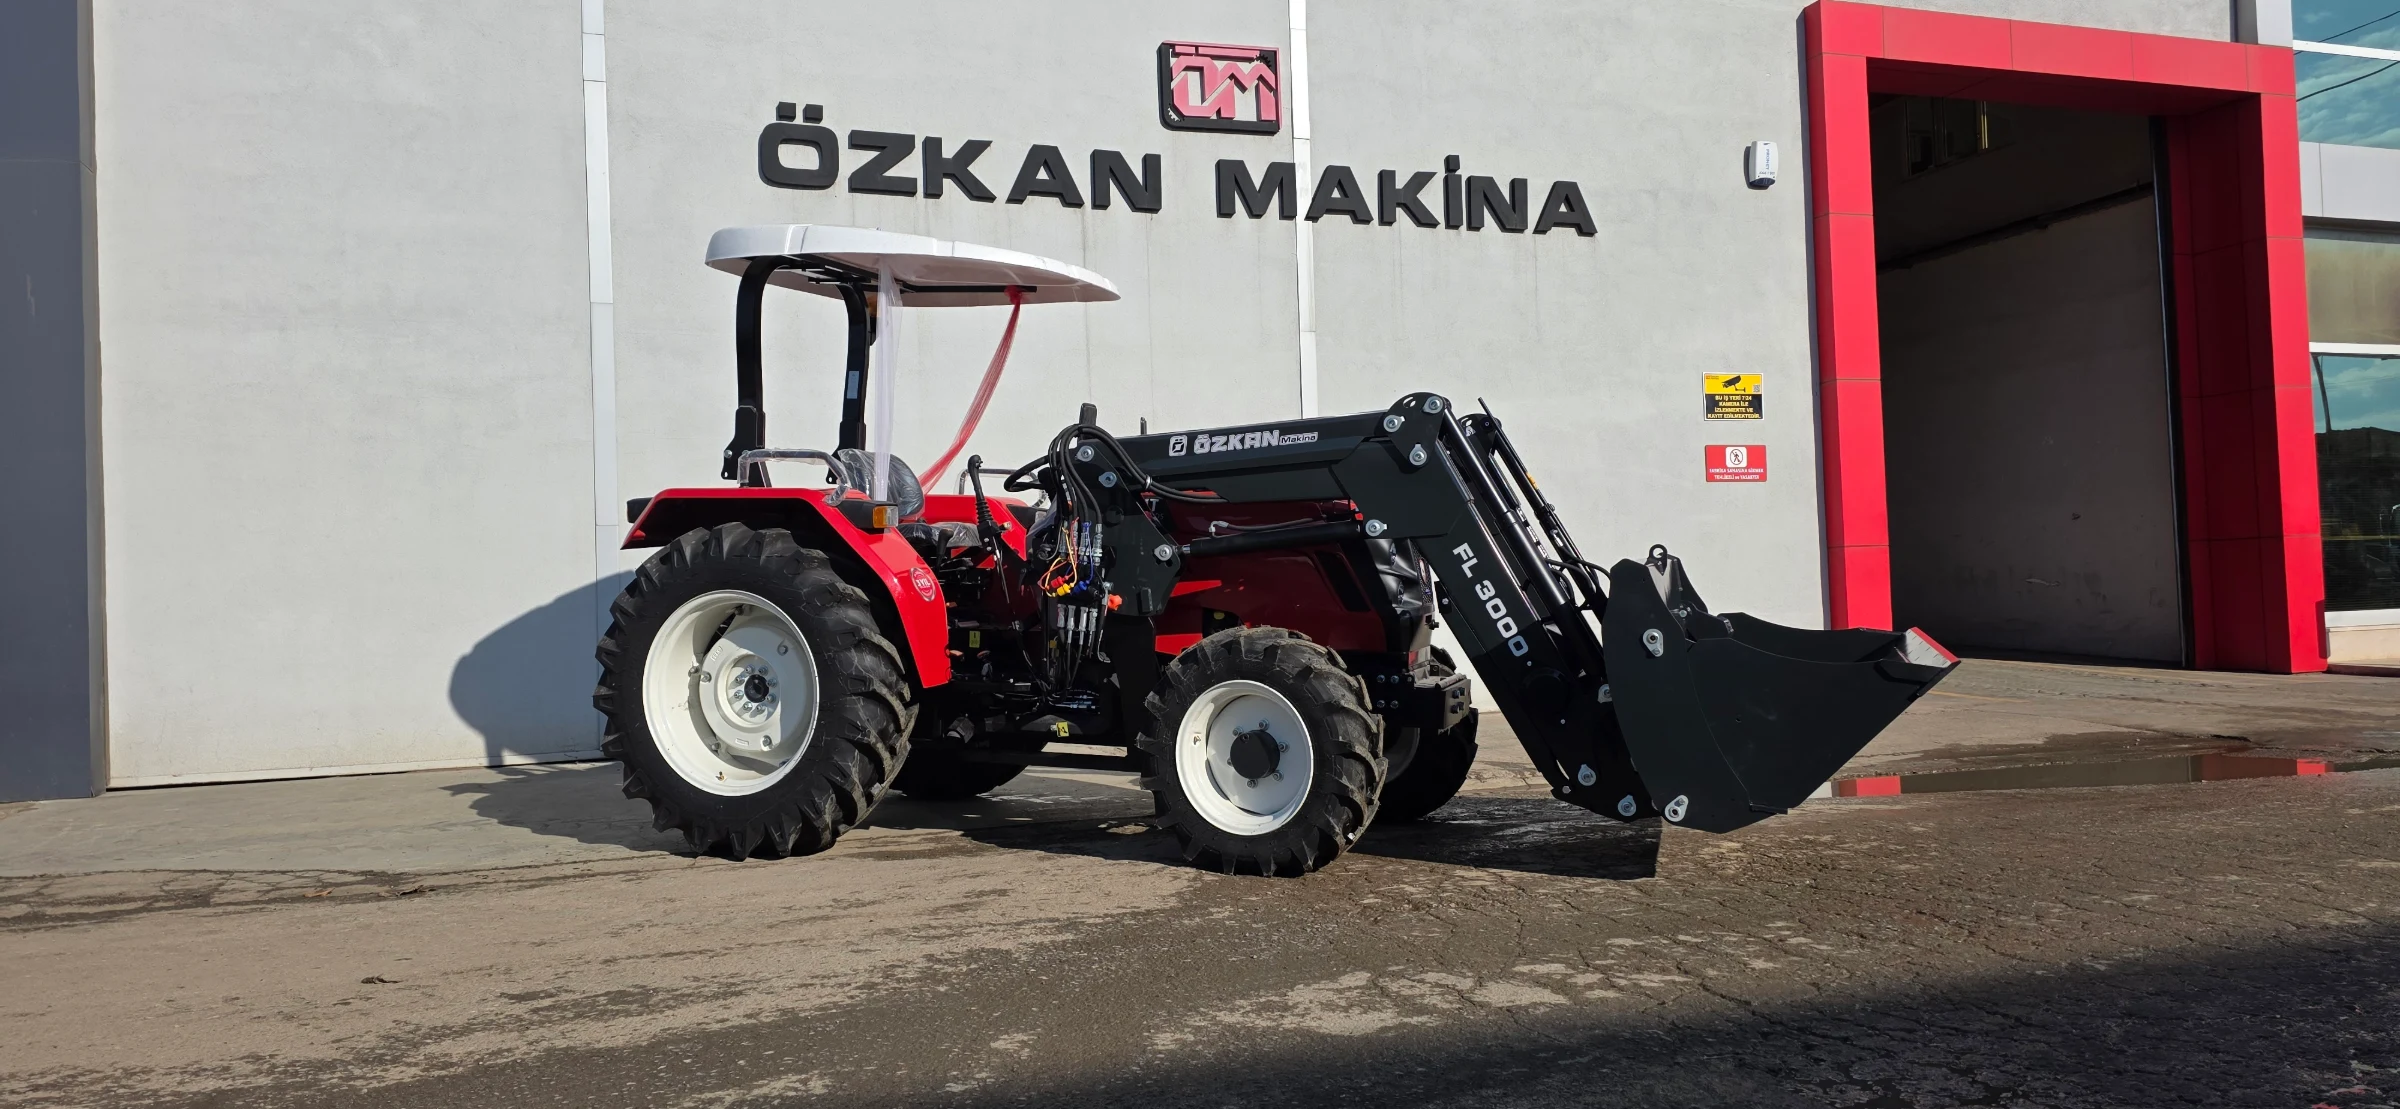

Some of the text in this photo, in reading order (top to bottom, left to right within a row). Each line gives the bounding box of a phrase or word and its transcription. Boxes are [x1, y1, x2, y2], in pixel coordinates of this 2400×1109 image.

[758, 102, 1598, 237] ÖZKAN MAKİNA
[1194, 430, 1279, 454] ÖZKAN
[1281, 433, 1317, 445] Makina
[1452, 542, 1528, 657] FL 3000
